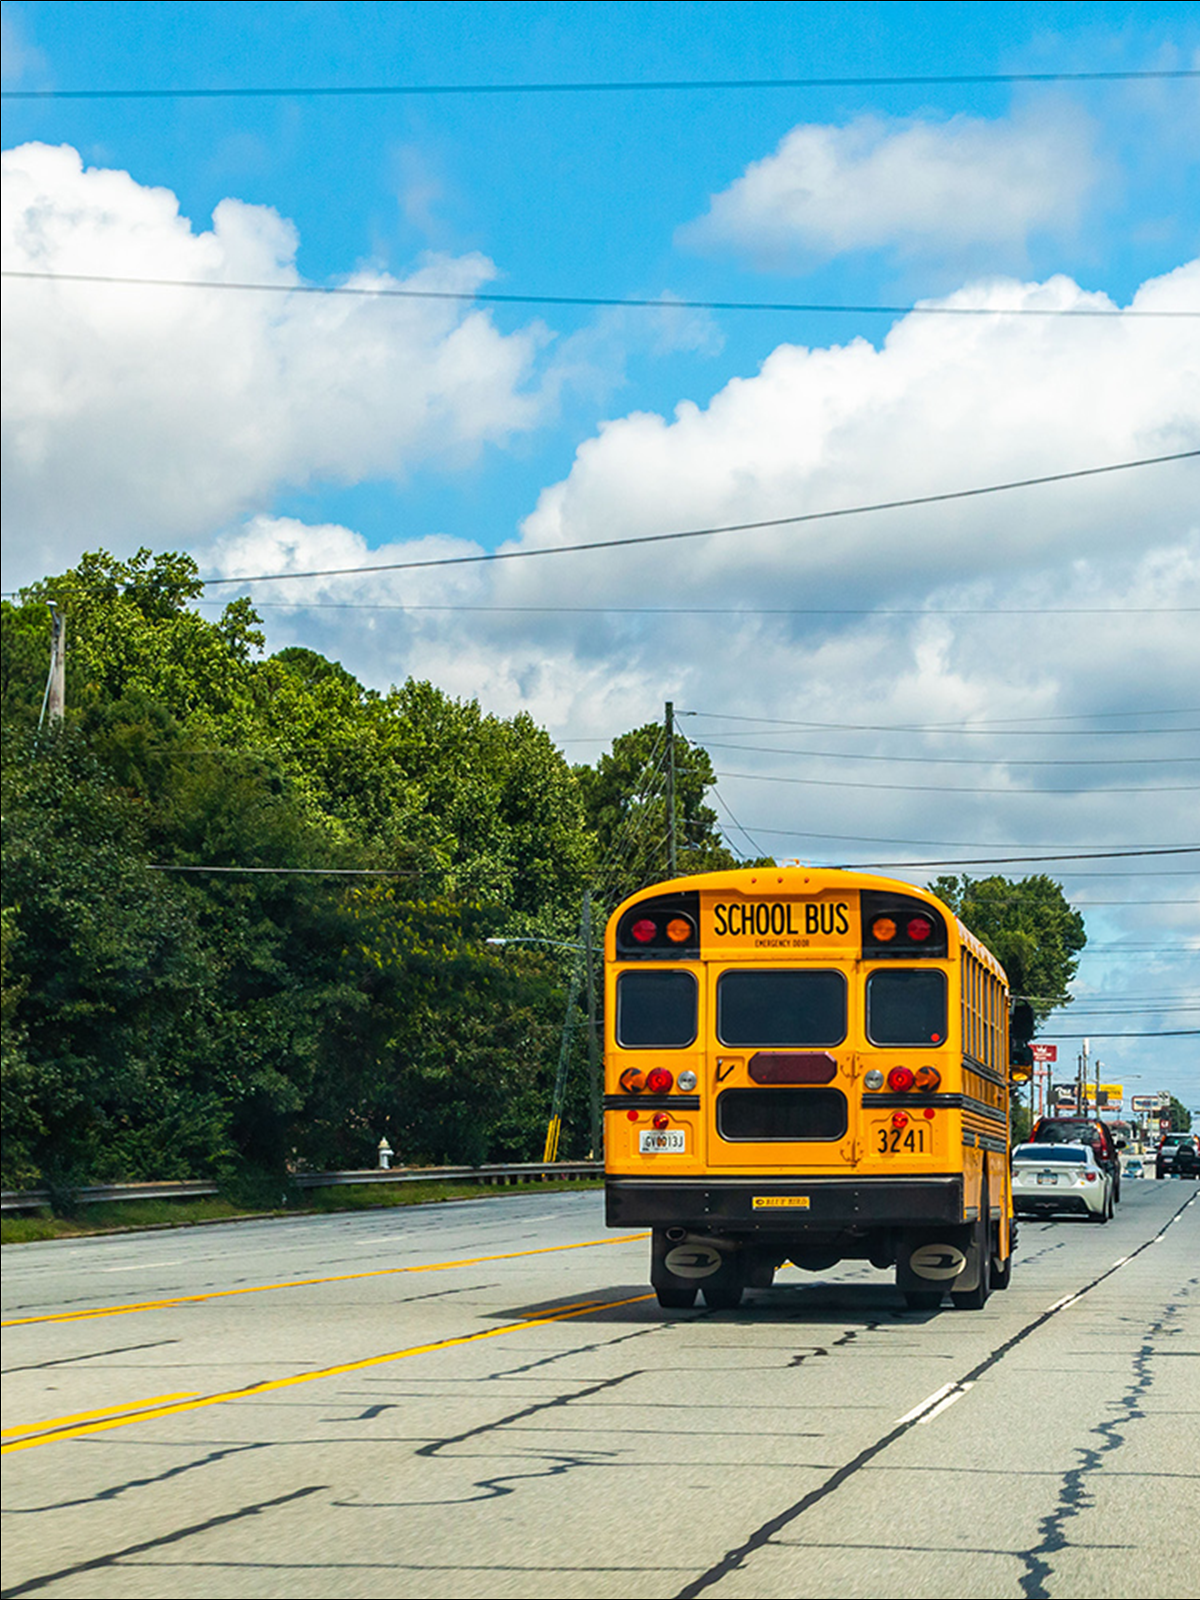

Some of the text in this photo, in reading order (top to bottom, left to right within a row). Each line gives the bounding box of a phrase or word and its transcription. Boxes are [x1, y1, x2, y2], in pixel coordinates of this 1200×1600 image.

[714, 903, 849, 936] SCHOOL BUS
[755, 939, 810, 948] EMERGENCY DOOR
[877, 1129, 924, 1153] 3241
